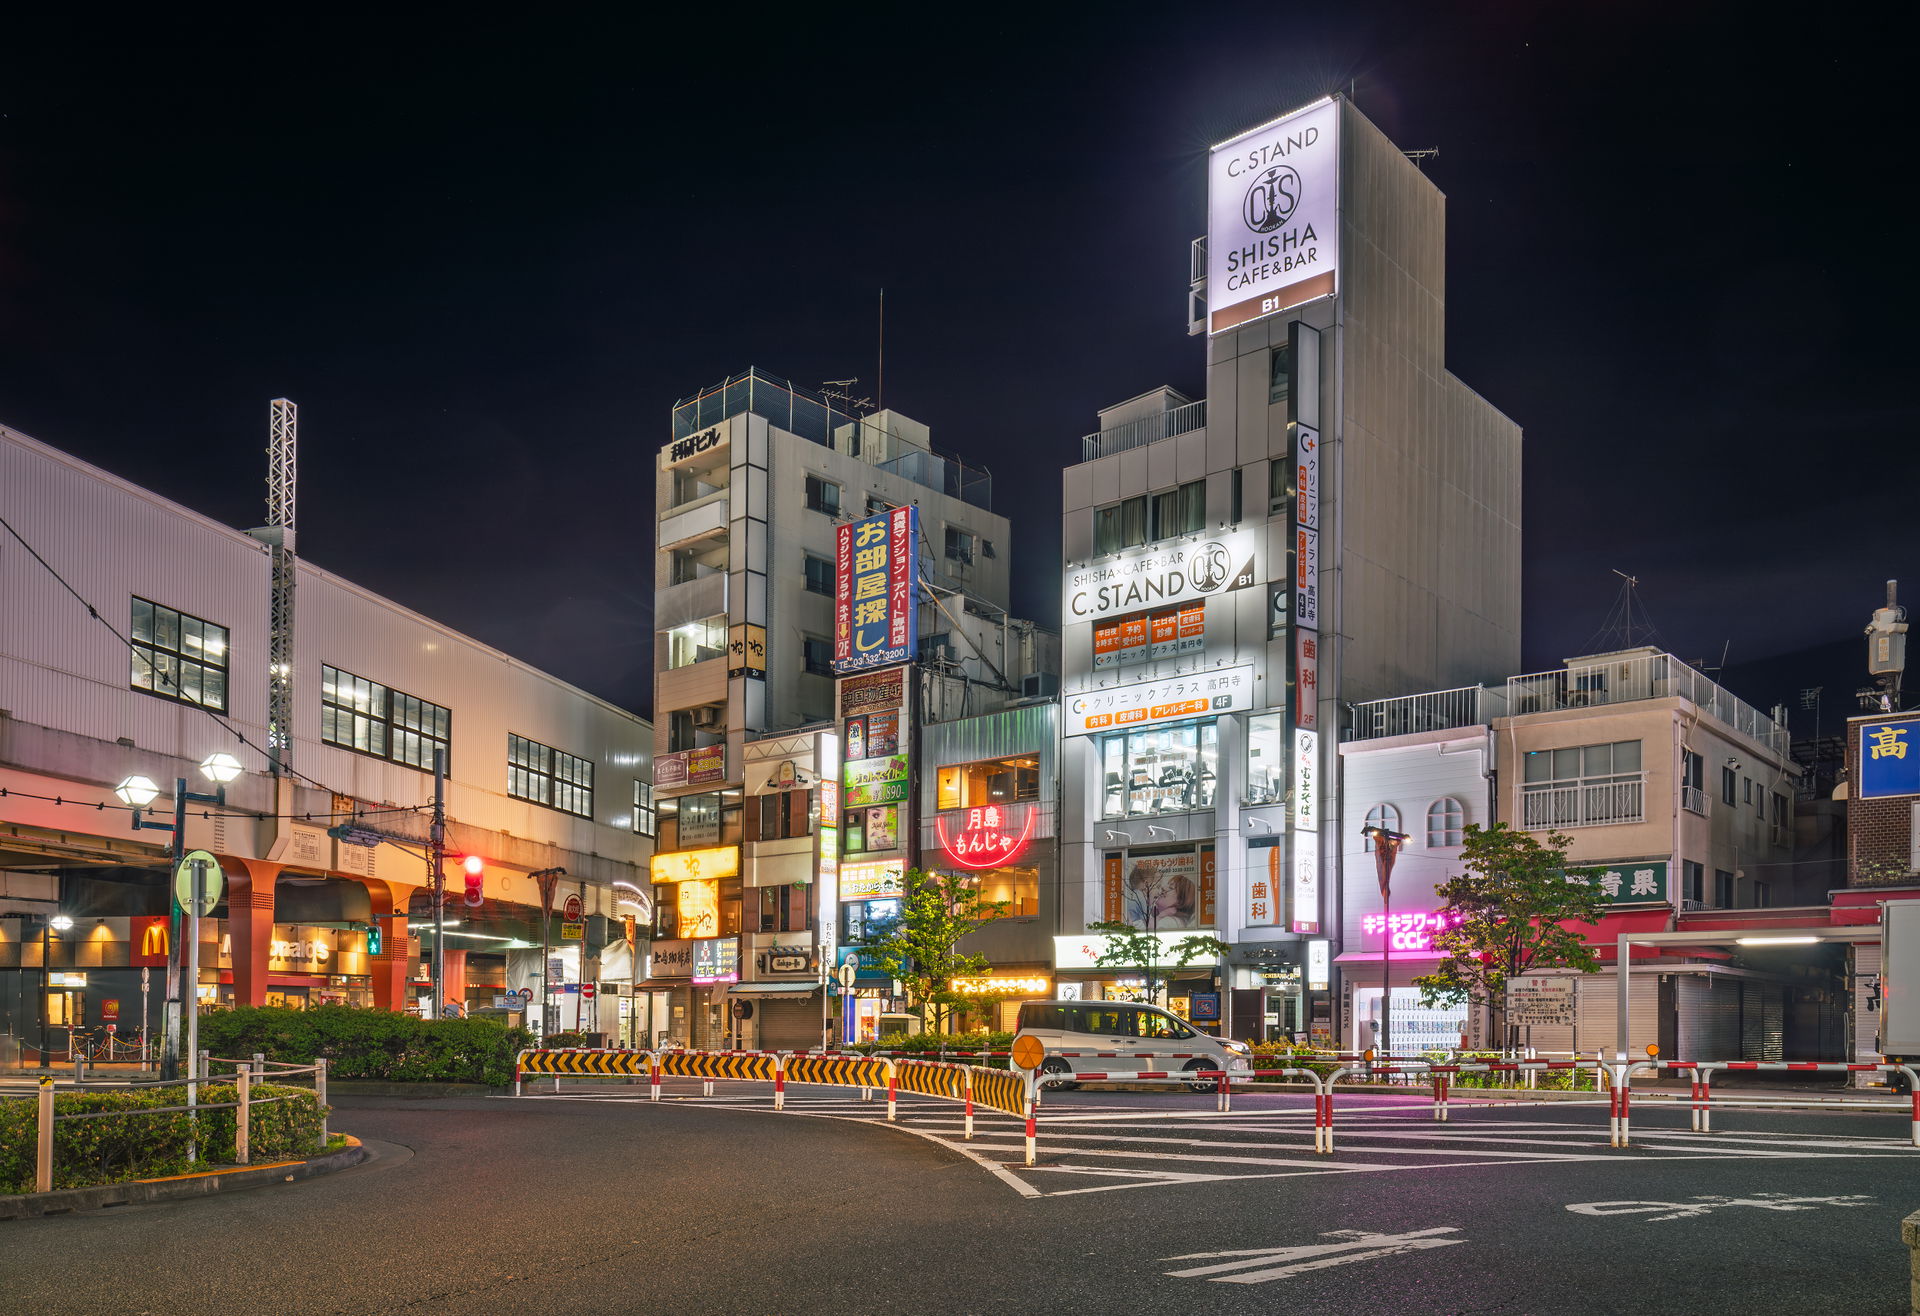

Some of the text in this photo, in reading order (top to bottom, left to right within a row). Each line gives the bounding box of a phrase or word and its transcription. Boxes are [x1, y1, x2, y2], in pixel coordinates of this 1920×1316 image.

[1227, 127, 1319, 178] C.STAND
[1227, 223, 1317, 273] SHISHA
[1227, 247, 1317, 291] CAFE&BAR
[1262, 296, 1279, 313] B1
[839, 528, 850, 572] ハウジング
[839, 575, 850, 600] プラザ
[855, 520, 887, 652] お部屋探し
[1238, 574, 1252, 586] B1
[1072, 571, 1184, 616] C.STAND
[1307, 585, 1316, 621] 高円寺
[1126, 625, 1142, 635] 予約
[1157, 628, 1173, 638] 診療
[838, 640, 850, 658] 2F
[1122, 635, 1145, 646] 受付中
[1180, 639, 1203, 650] 高円寺
[1302, 638, 1316, 690] 歯科
[1207, 675, 1241, 691] 高円寺
[1154, 701, 1204, 717] アレルギー科
[1215, 696, 1229, 708] 4F
[1090, 715, 1107, 727] 内科
[1119, 710, 1144, 723] 皮膚科
[1304, 714, 1315, 724] 2F
[1869, 726, 1908, 760] 高
[967, 807, 1001, 831] 月島
[956, 833, 1012, 855] もんじゃ
[1252, 882, 1268, 920] 歯科
[1301, 922, 1309, 931] B1
[1363, 911, 1462, 935] キラキラワール
